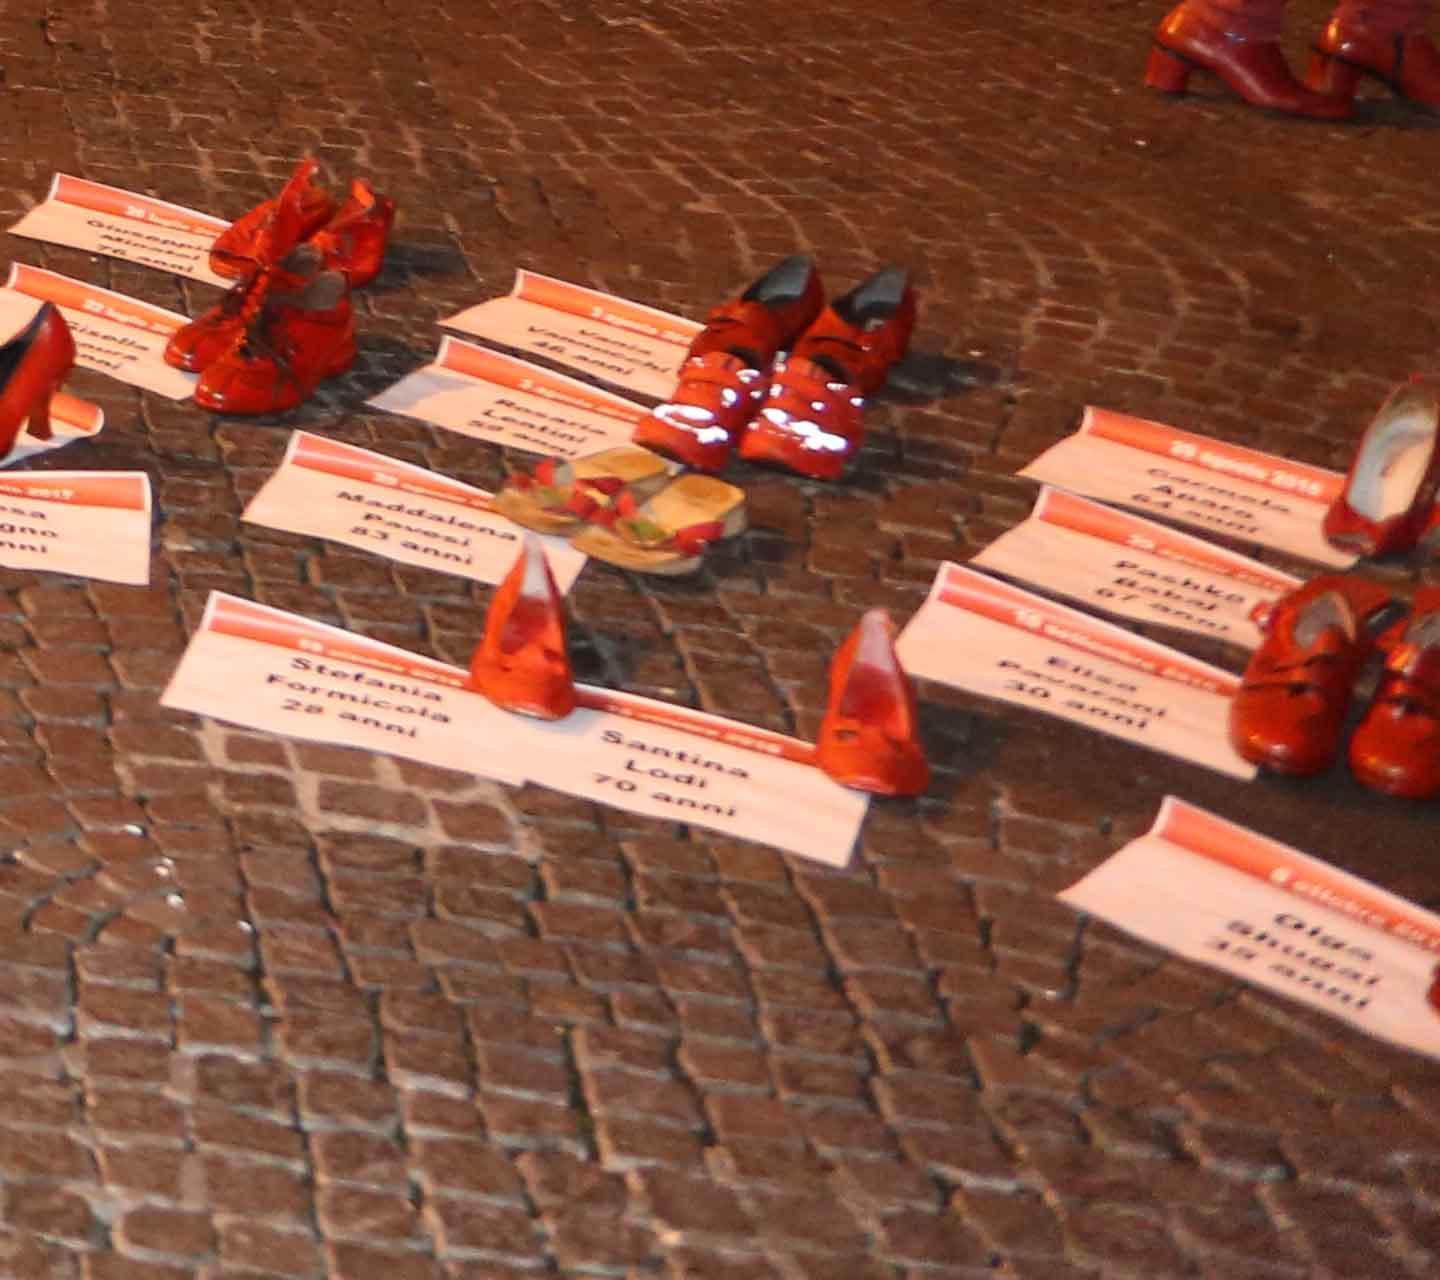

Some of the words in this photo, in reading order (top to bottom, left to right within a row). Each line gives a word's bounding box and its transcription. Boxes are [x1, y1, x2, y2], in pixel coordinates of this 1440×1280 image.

[135, 255, 196, 274] anni
[570, 354, 636, 377] anni
[480, 407, 589, 445] Lentini
[492, 397, 608, 437] Rosaria
[511, 431, 579, 458] anni
[1145, 466, 1292, 515] Carmela
[335, 488, 519, 543] Maddalena
[361, 511, 474, 549] Pavesi
[1182, 509, 1261, 535] anni
[399, 540, 474, 567] anni
[289, 655, 444, 703] Stefania
[1044, 654, 1138, 693] Elisa
[265, 671, 454, 725] Formicola
[1061, 699, 1148, 730] anni
[279, 696, 326, 713] 28
[336, 710, 419, 740] anni
[599, 727, 753, 780] Santina
[622, 757, 709, 791] Lodi
[591, 770, 638, 793] 70
[648, 789, 738, 819] anni
[1266, 963, 1372, 1010] anni
